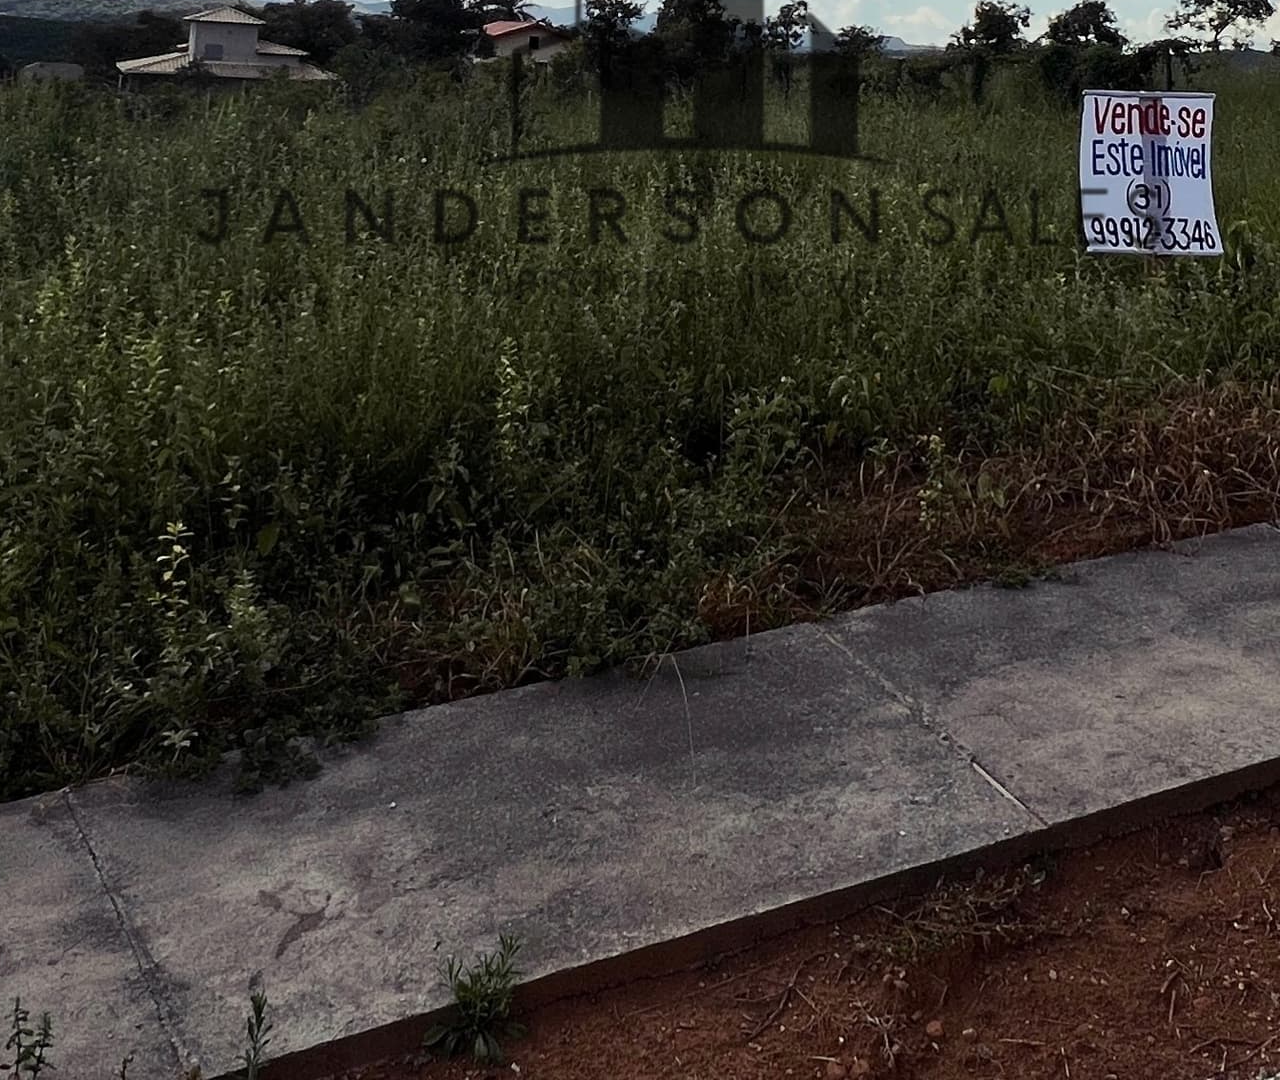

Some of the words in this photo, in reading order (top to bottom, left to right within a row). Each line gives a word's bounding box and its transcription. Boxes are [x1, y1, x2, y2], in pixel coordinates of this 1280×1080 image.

[1094, 97, 1206, 138] Vende-se
[1092, 138, 1144, 177] Este
[1150, 140, 1207, 180] Imóvel
[1126, 178, 1172, 217] (31)
[1091, 217, 1216, 251] 99912-3346
